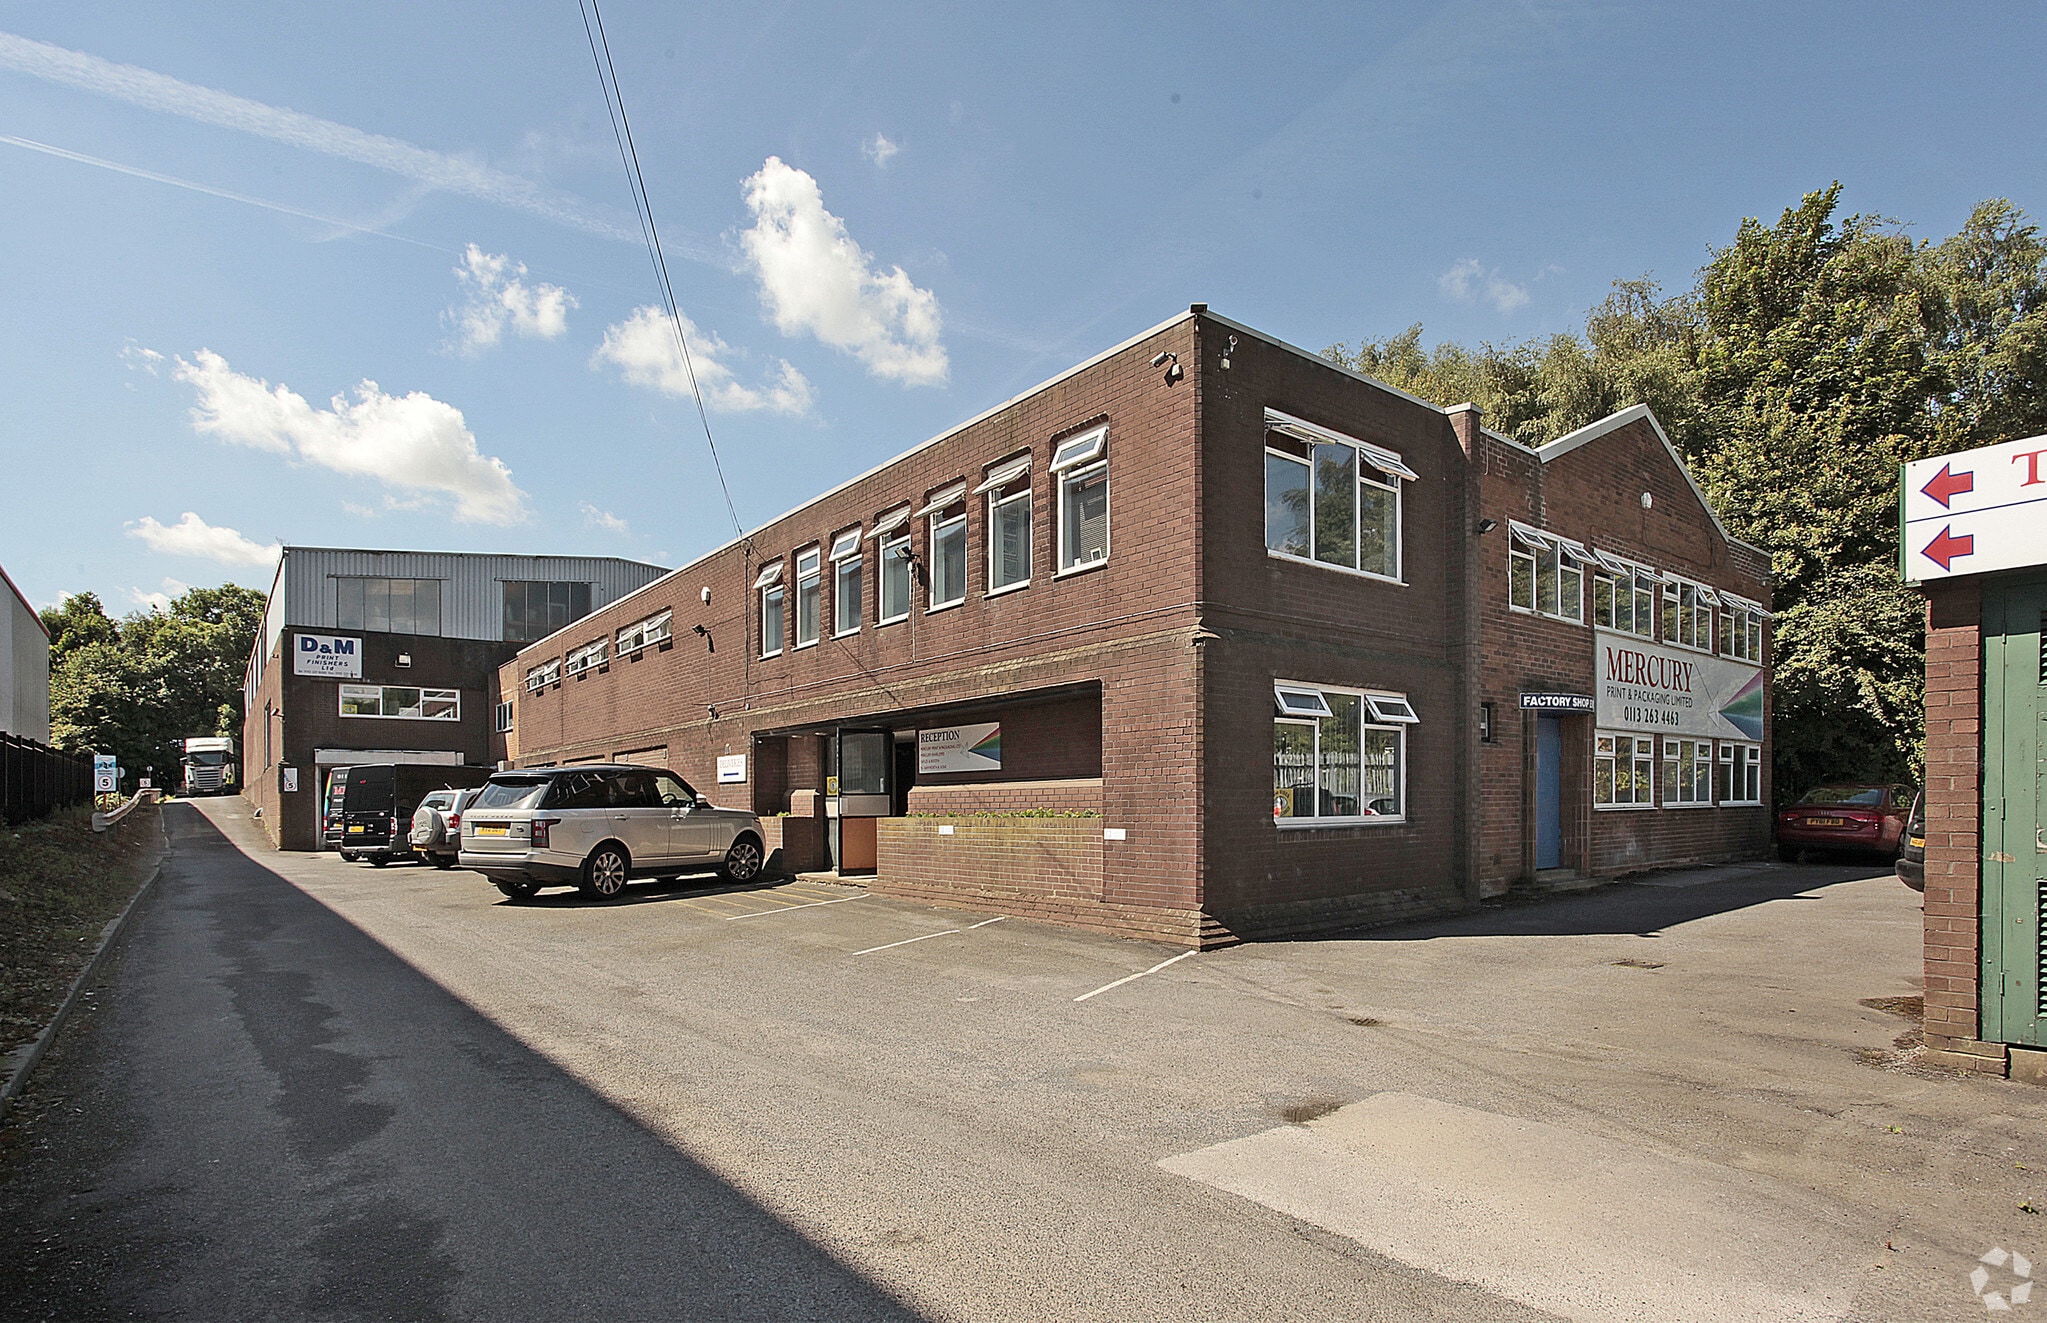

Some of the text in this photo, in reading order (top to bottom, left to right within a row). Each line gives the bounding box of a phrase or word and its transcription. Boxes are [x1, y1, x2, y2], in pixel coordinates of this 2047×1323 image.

[301, 636, 354, 655] D&M
[306, 659, 349, 667] FINISHERS
[1606, 646, 1693, 693] MERCURY
[1523, 695, 1572, 707] FACTORY
[1572, 697, 1589, 708] SHOP
[1606, 685, 1693, 708] PRINT & PACKAGING LIMITED
[1624, 706, 1679, 726] 0113 263 4463
[920, 730, 960, 743] RECEPTION
